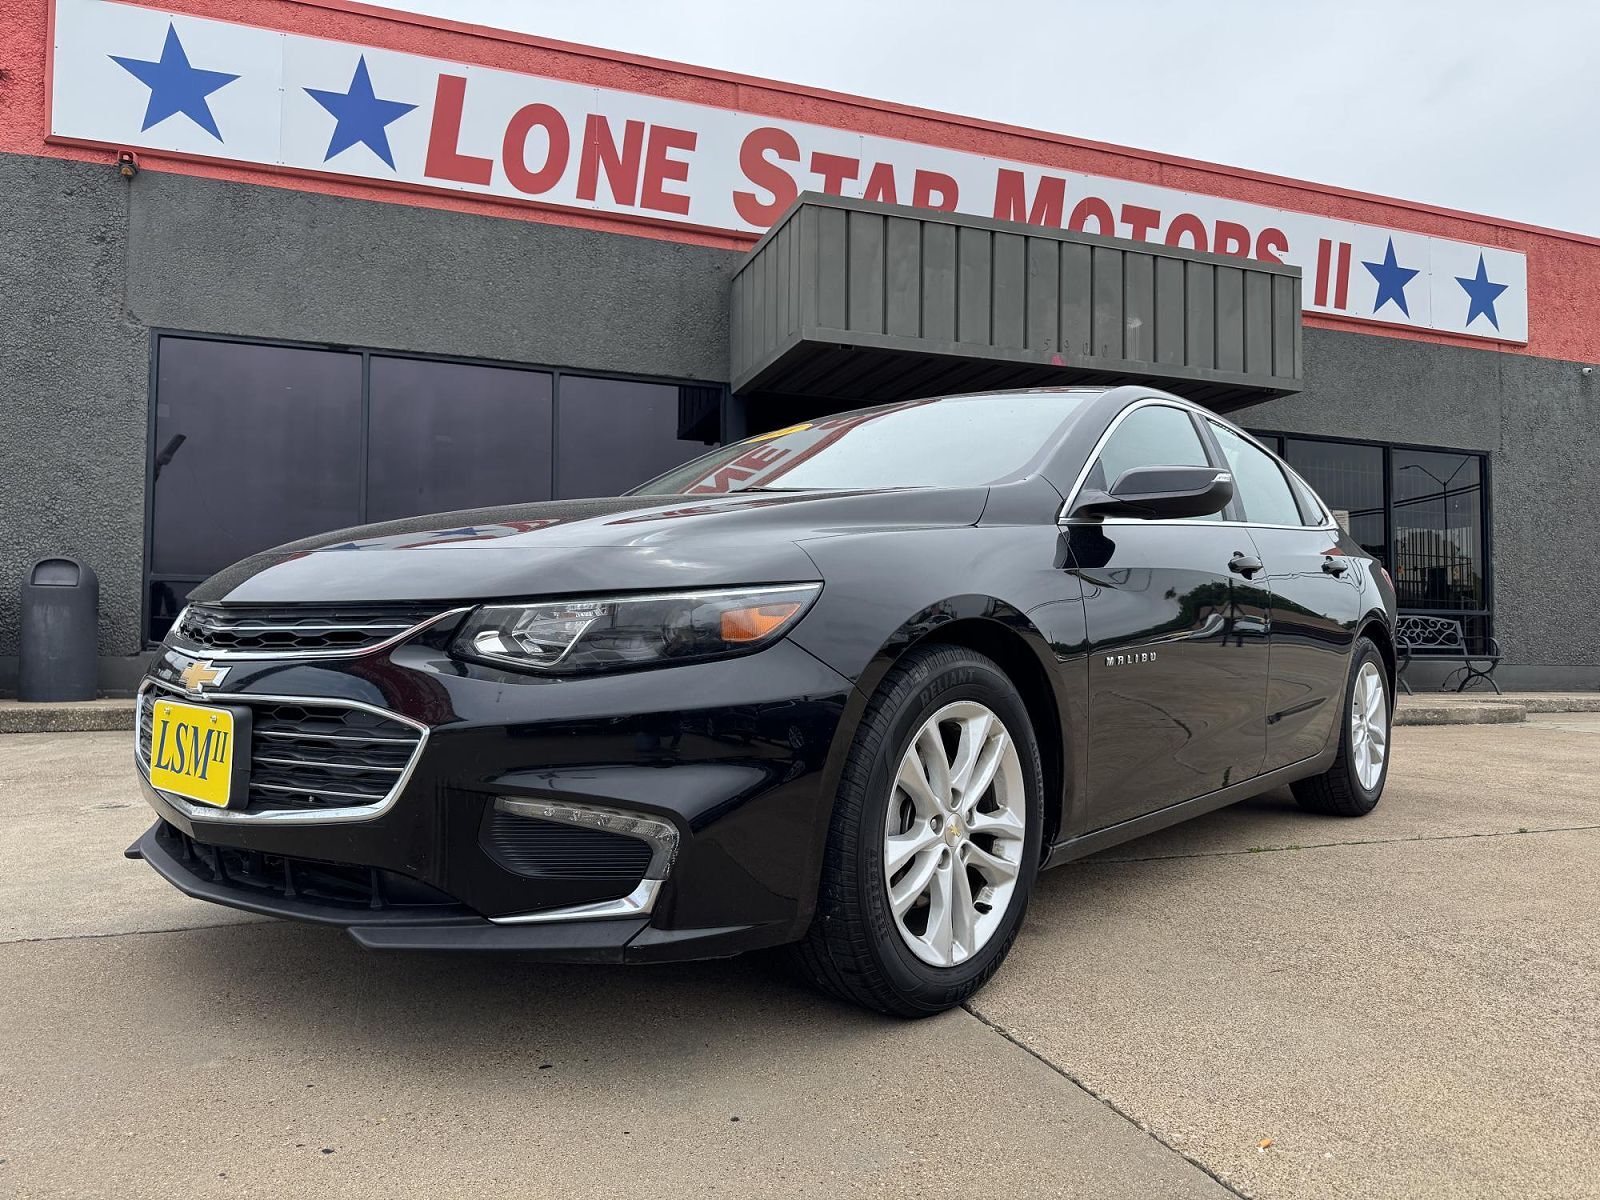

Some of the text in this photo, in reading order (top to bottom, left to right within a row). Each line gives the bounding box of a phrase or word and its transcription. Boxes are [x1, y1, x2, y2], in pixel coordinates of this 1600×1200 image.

[424, 73, 698, 216] LONE
[1314, 238, 1352, 310] II
[1105, 652, 1157, 667] MALIBU
